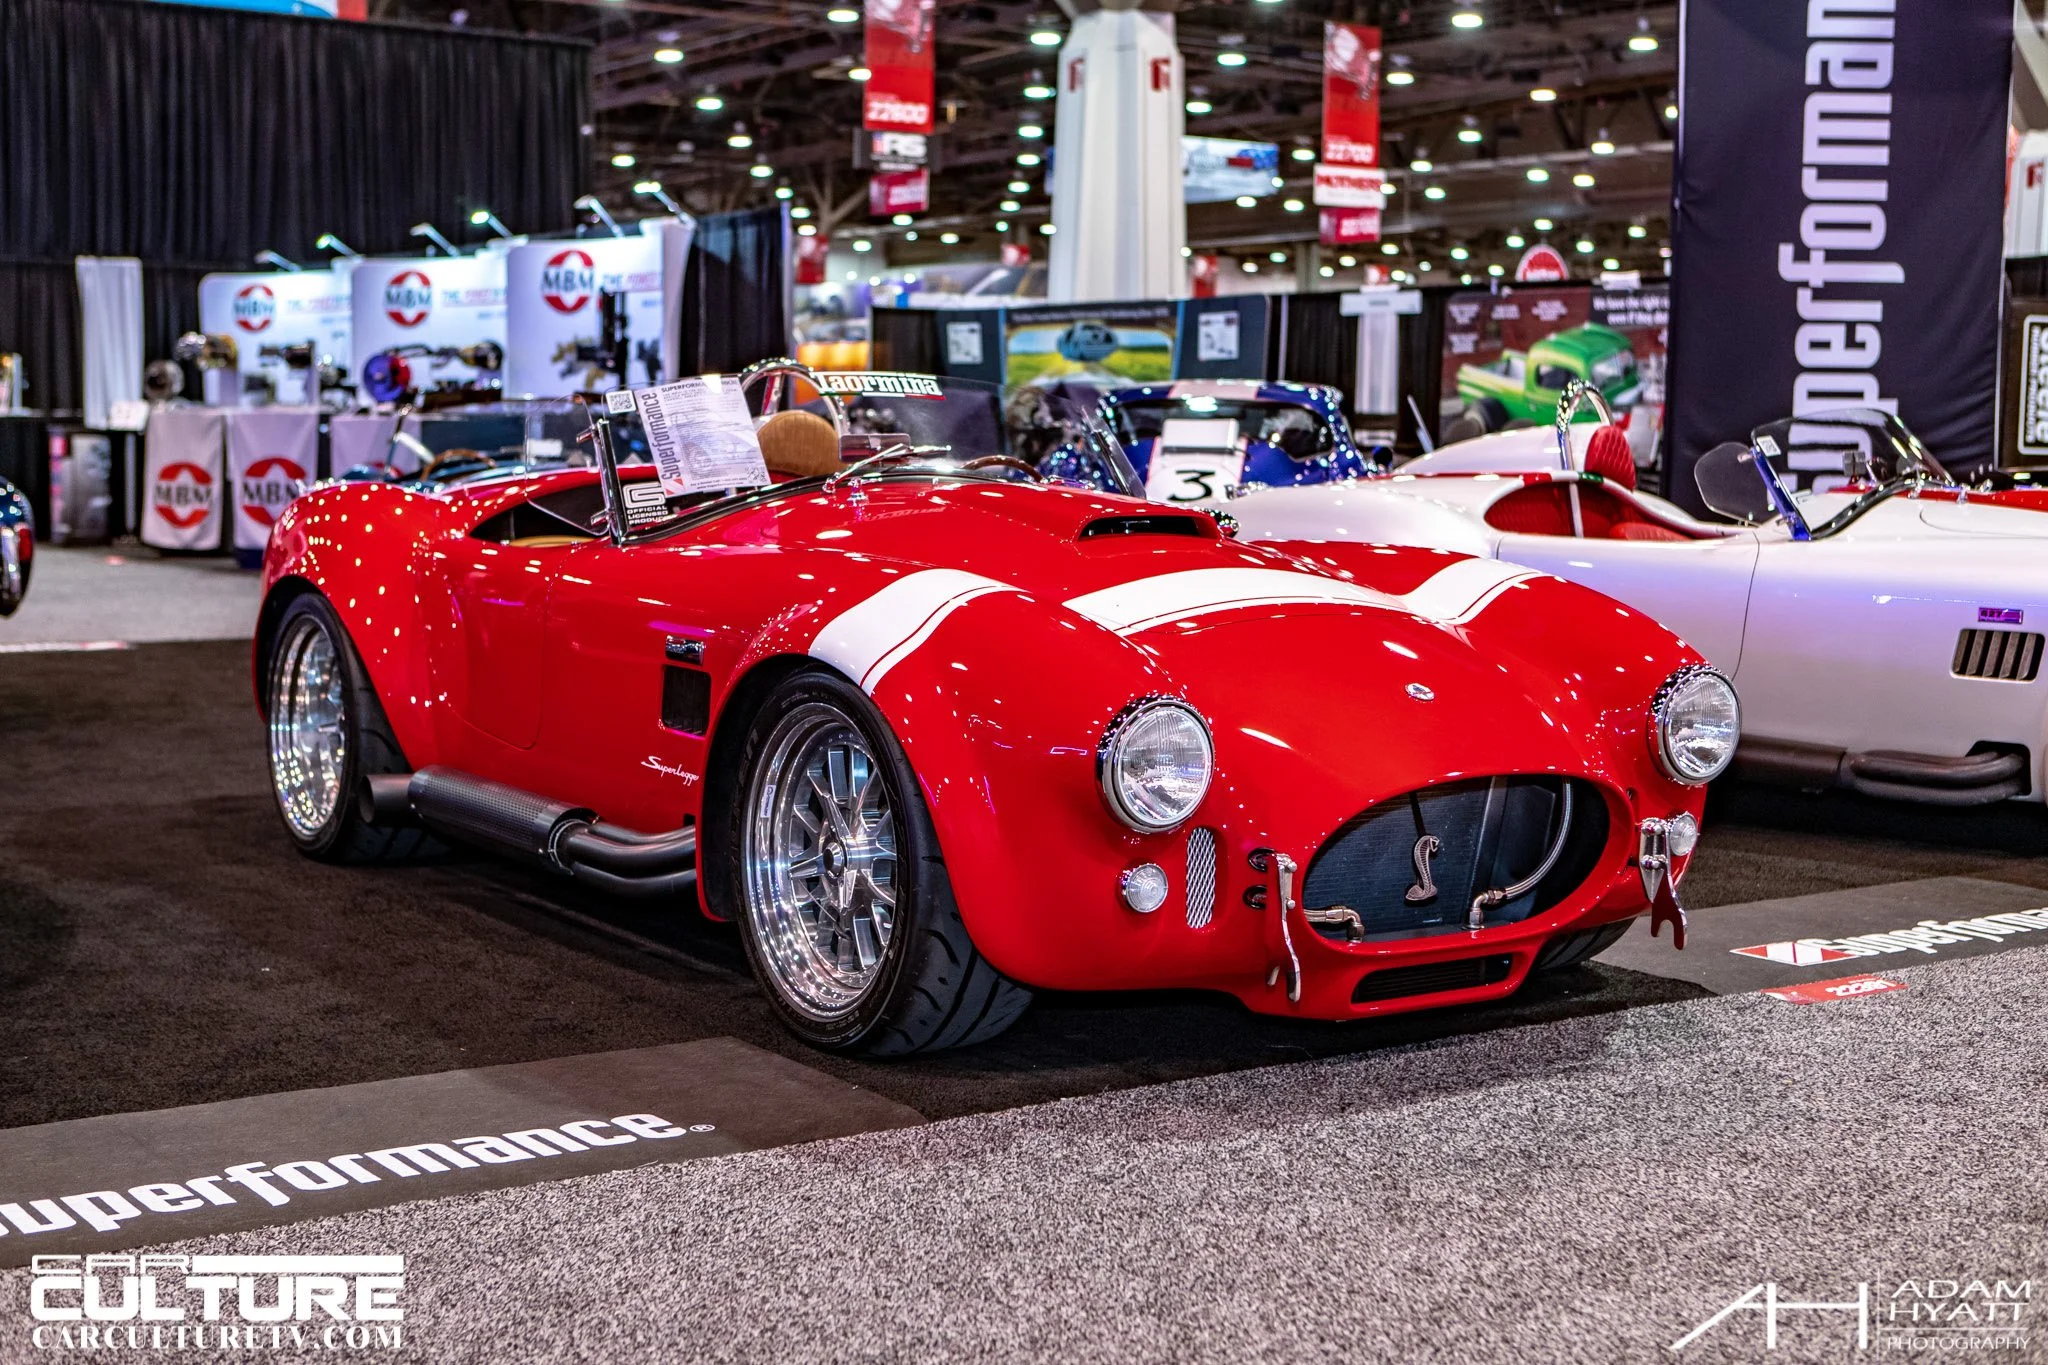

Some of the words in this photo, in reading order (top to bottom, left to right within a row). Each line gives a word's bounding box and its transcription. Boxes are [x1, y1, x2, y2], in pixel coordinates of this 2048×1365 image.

[541, 267, 594, 292] MBM
[385, 285, 432, 308] MBM
[808, 371, 943, 396] Taormina
[641, 392, 682, 480] Superformance
[154, 482, 212, 503] MBM
[1168, 469, 1216, 502] 3
[627, 505, 667, 515] OFFICIAL
[628, 510, 669, 520] LICENSED
[0, 1113, 687, 1237] uperformance
